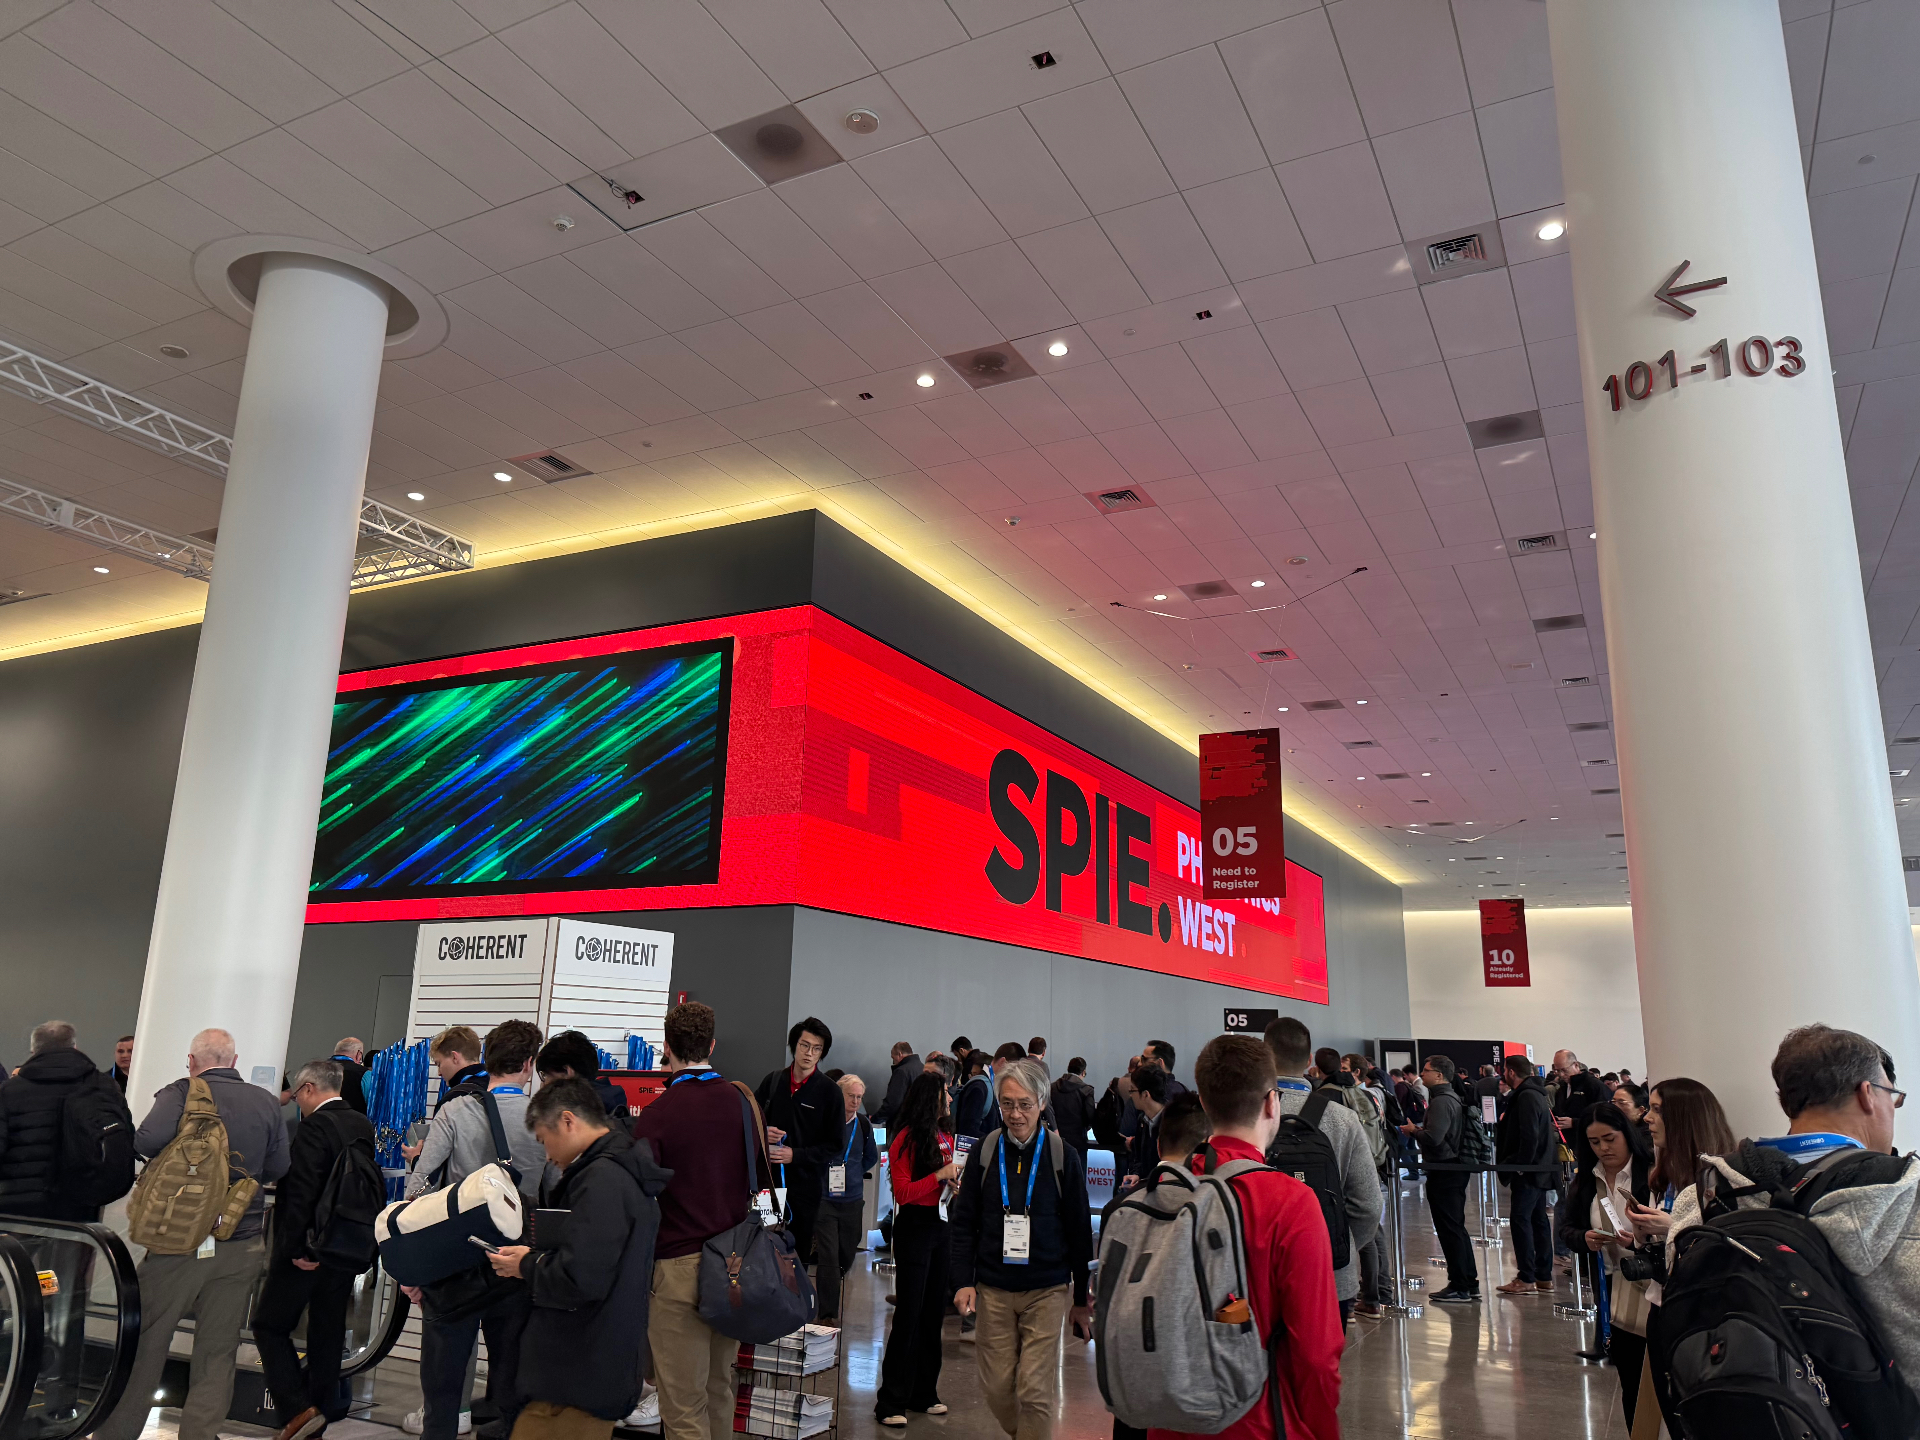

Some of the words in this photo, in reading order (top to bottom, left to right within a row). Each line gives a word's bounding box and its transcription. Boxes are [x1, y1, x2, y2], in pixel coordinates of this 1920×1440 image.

[1602, 335, 1806, 411] 101-103
[984, 748, 1172, 944] SPIE.
[1212, 826, 1258, 857] 05
[1212, 867, 1241, 877] Need
[1244, 867, 1257, 876] to
[1212, 880, 1260, 890] Register
[1177, 895, 1236, 957] WEST
[438, 934, 528, 961] COHERENT
[575, 935, 659, 967] COHERENT
[1489, 949, 1515, 965] 10
[1227, 1013, 1248, 1027] 05
[1492, 1045, 1500, 1065] SPIE.
[1087, 1177, 1114, 1187] WEST
